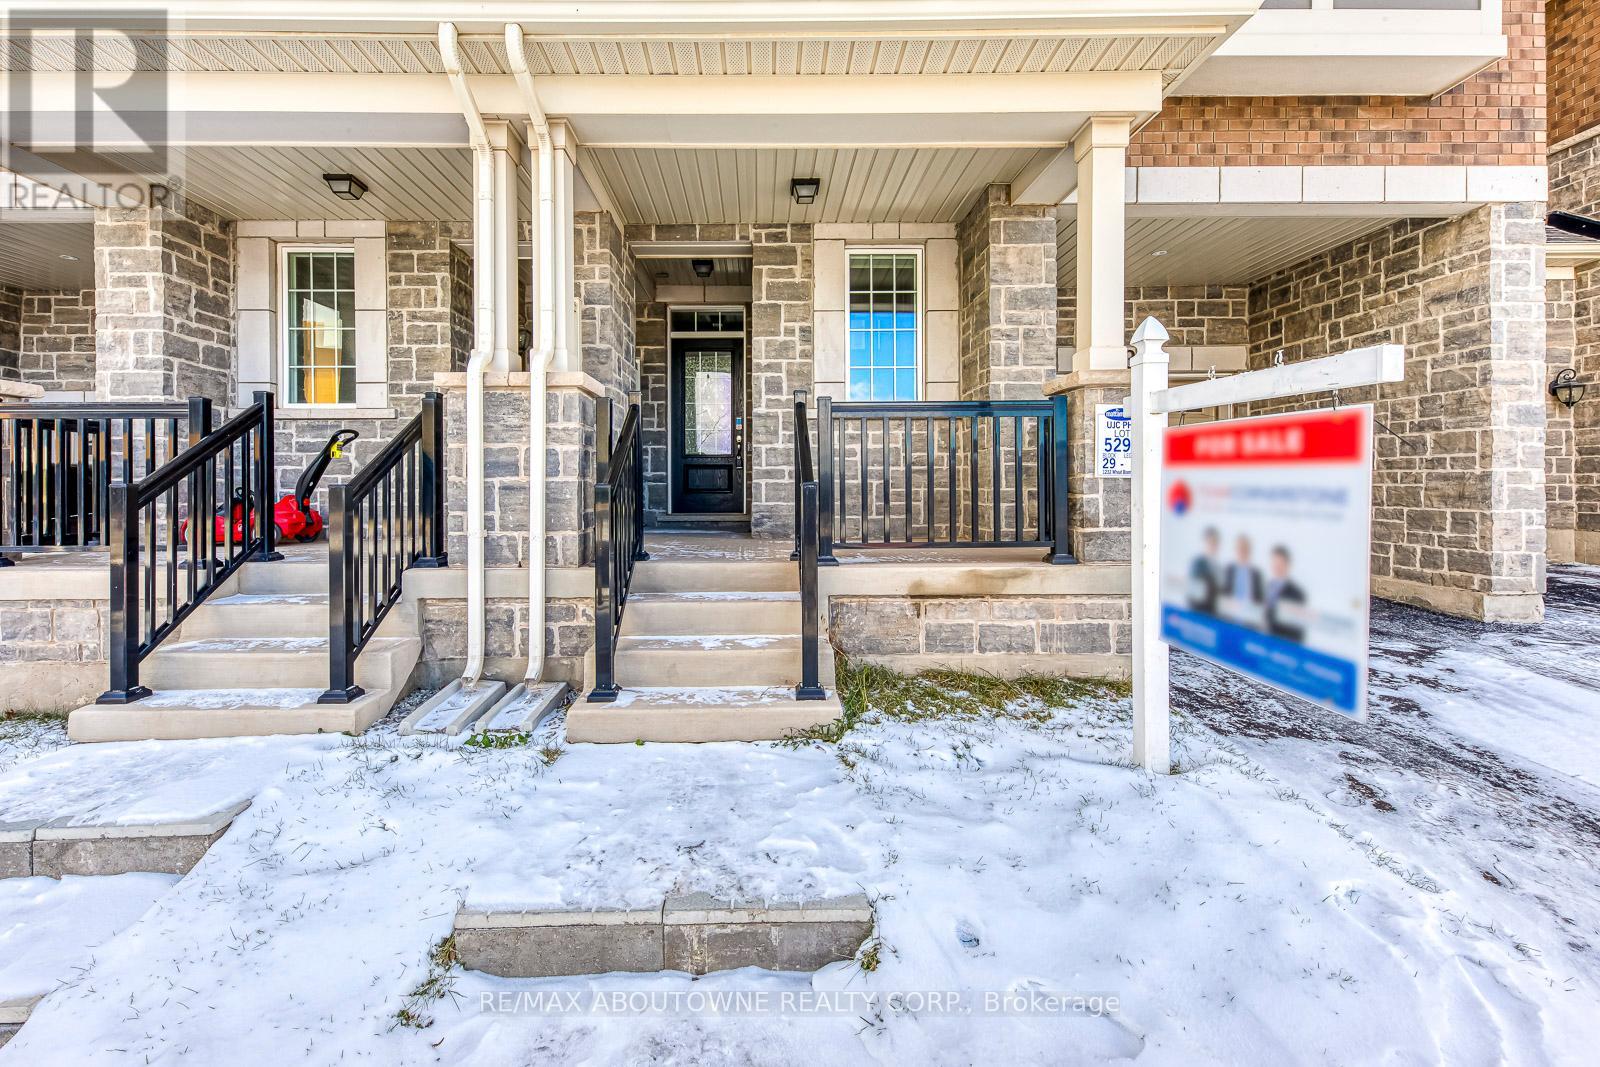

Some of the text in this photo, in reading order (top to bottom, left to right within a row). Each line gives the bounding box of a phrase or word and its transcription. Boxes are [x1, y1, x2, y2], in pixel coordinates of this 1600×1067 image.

[1106, 421, 1120, 429] UJC
[1105, 438, 1131, 452] 529
[1102, 458, 1115, 468] 29
